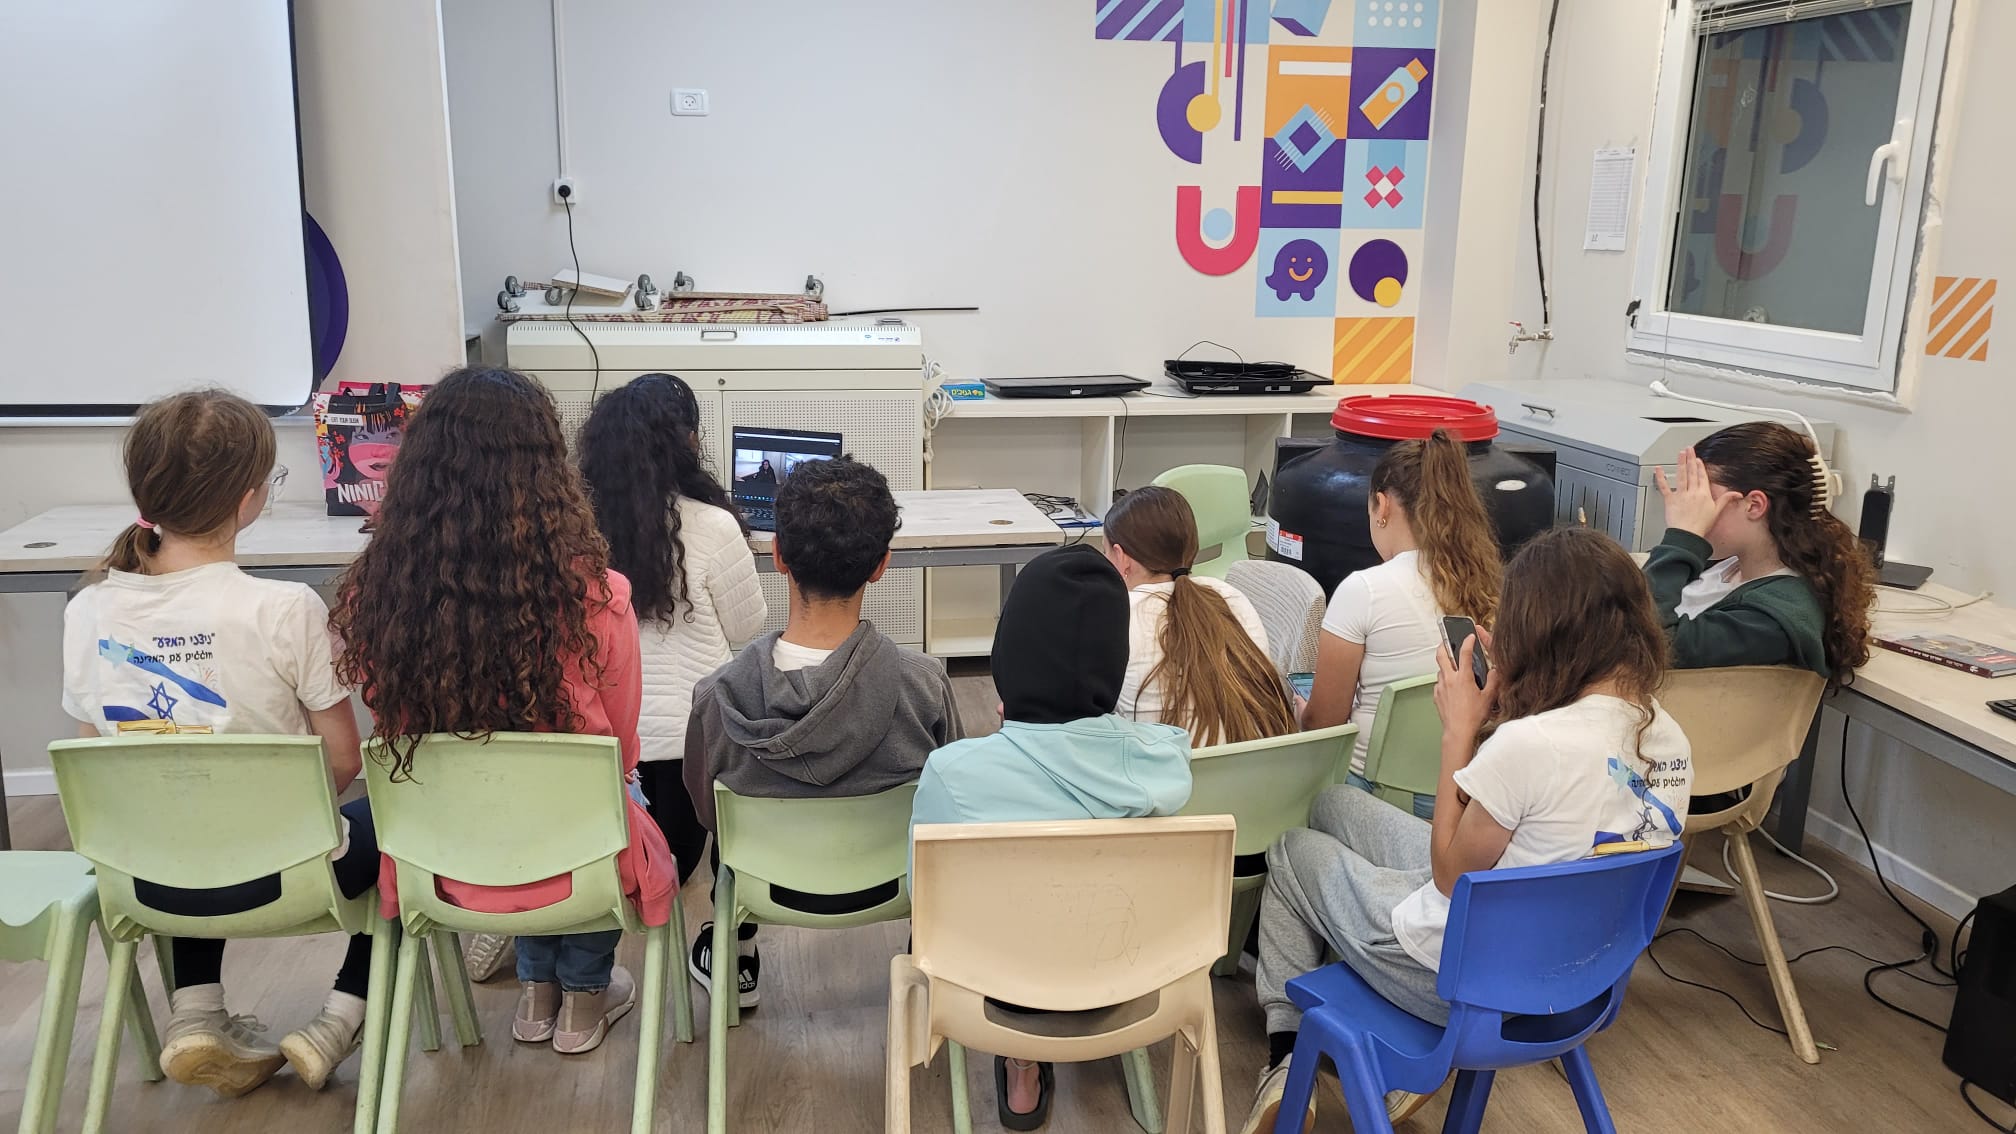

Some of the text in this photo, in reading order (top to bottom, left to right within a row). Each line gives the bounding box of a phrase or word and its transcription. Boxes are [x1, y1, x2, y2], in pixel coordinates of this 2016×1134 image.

[133, 650, 213, 664] חוגגים עם המדינה
